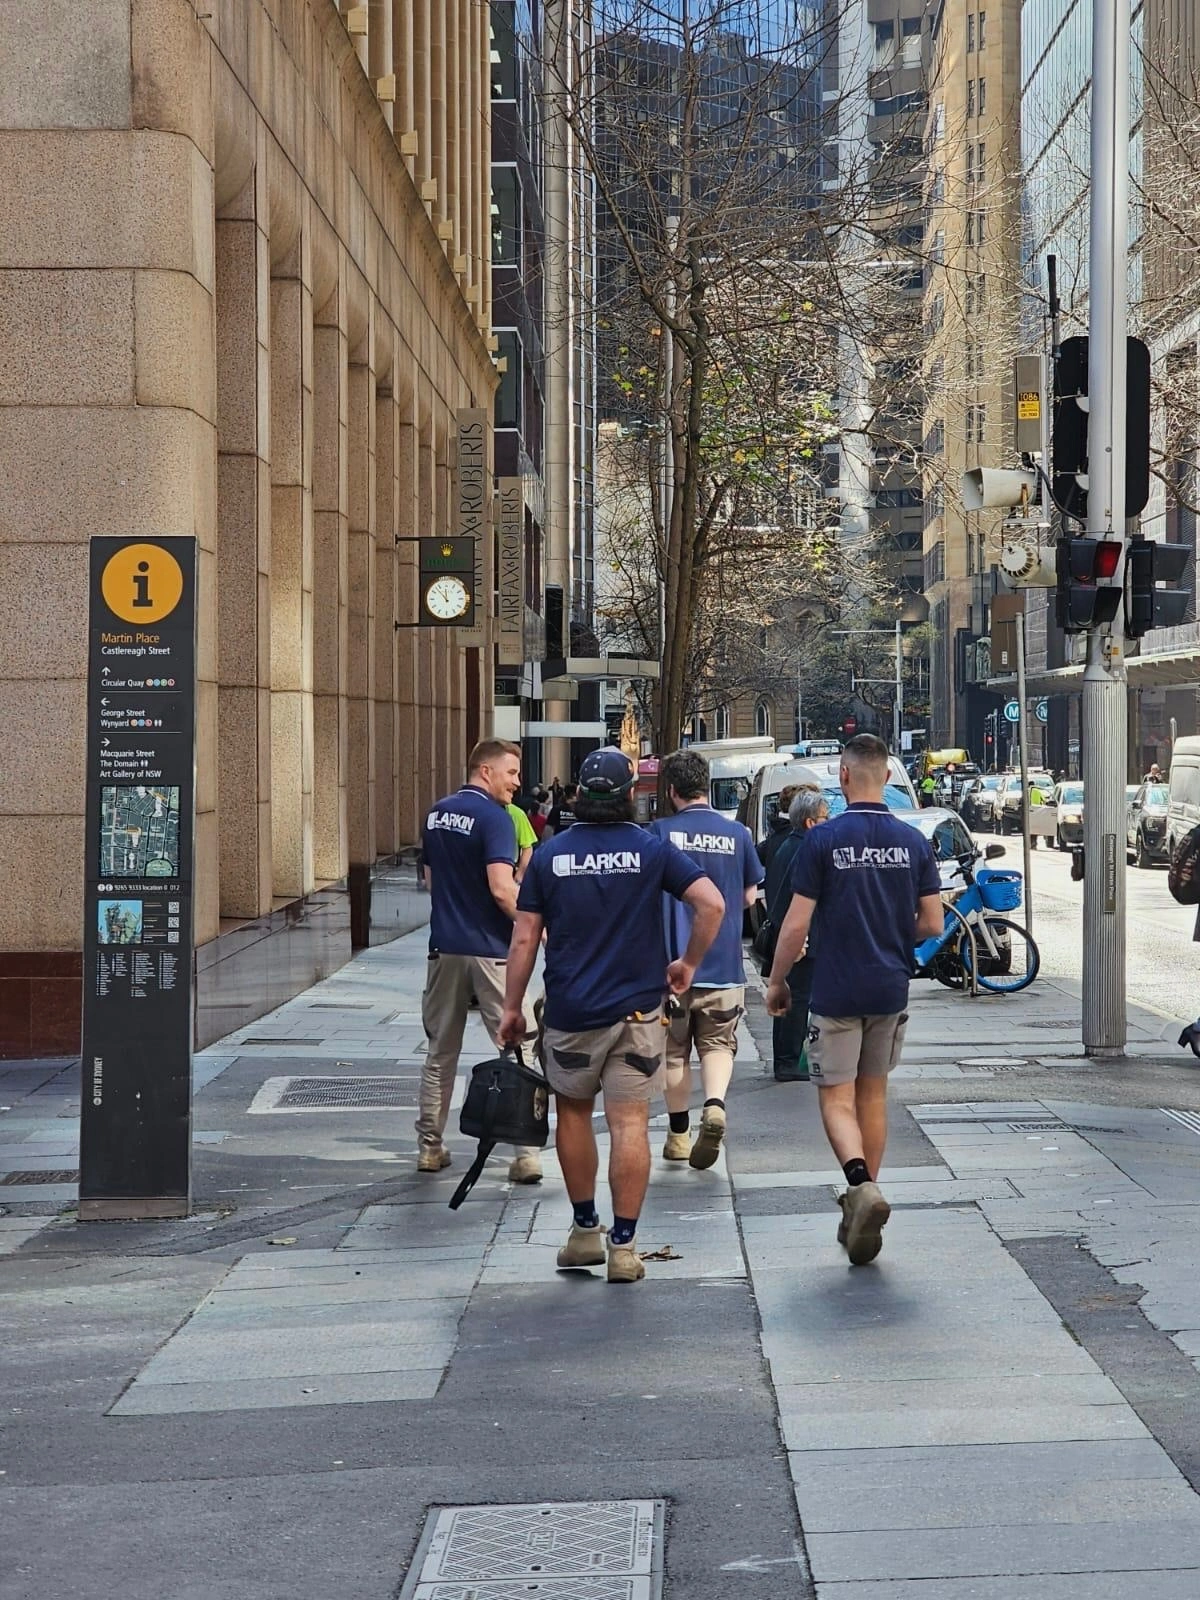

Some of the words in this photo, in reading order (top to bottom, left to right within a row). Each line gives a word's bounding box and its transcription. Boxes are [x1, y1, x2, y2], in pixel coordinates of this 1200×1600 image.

[101, 633, 132, 644] Martin
[136, 633, 160, 644] Place
[101, 646, 146, 657] Castlereagh
[148, 646, 171, 655] Street
[101, 679, 126, 687] Circular
[127, 679, 145, 689] Quay
[101, 709, 125, 719] George
[126, 709, 146, 717] Street
[100, 719, 130, 729] Wynyard
[100, 750, 134, 759] Macquarie
[135, 750, 156, 758] Street
[100, 760, 112, 768] The
[113, 760, 139, 768] Domain
[100, 770, 111, 778] Art
[112, 770, 135, 780] Gallery
[136, 770, 144, 778] of
[145, 770, 162, 778] NSW
[684, 832, 735, 851] LARKIN
[850, 846, 910, 864] LARKIN
[571, 851, 640, 870] LARKIN
[570, 868, 602, 876] ELECTRICAL
